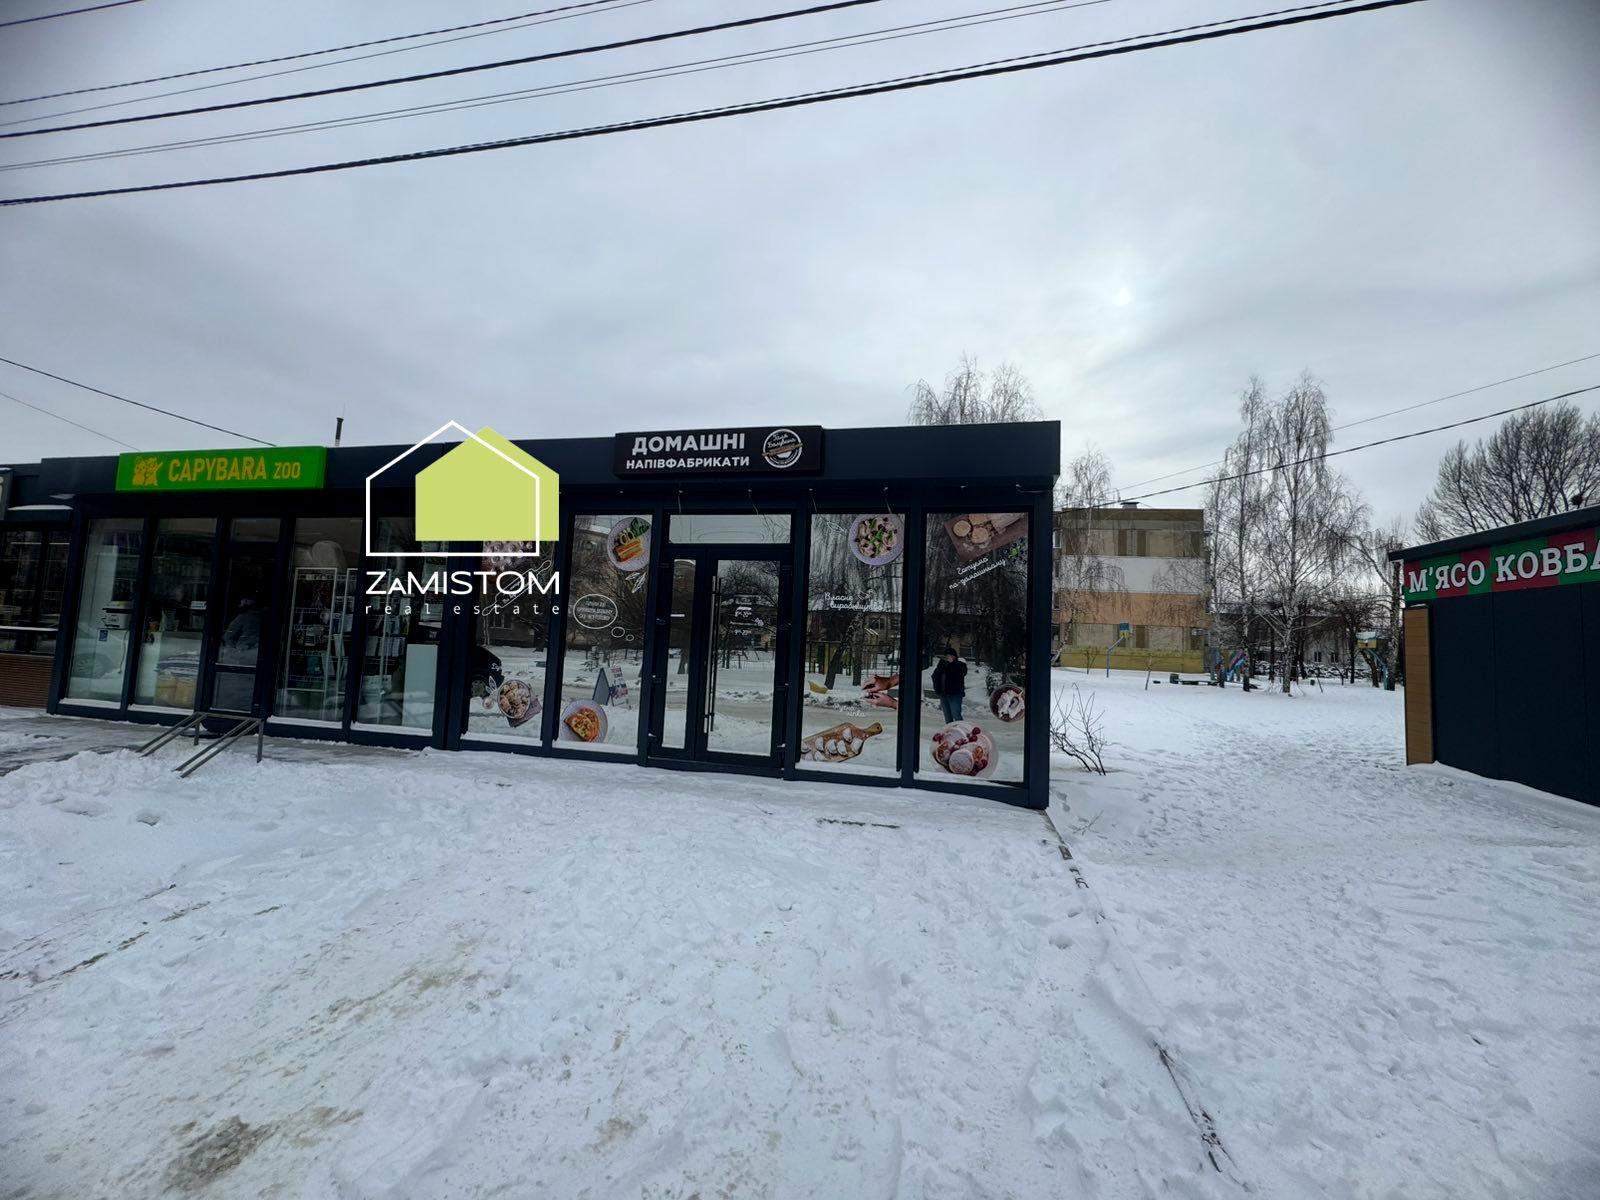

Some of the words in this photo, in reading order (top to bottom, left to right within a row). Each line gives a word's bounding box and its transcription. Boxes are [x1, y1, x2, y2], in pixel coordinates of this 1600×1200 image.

[631, 433, 746, 456] ДОМАШНІ
[167, 456, 267, 482] CAPYBARA
[626, 456, 750, 470] НАПІВФАБРИКАТИ
[1408, 560, 1486, 593] М'ЯСО
